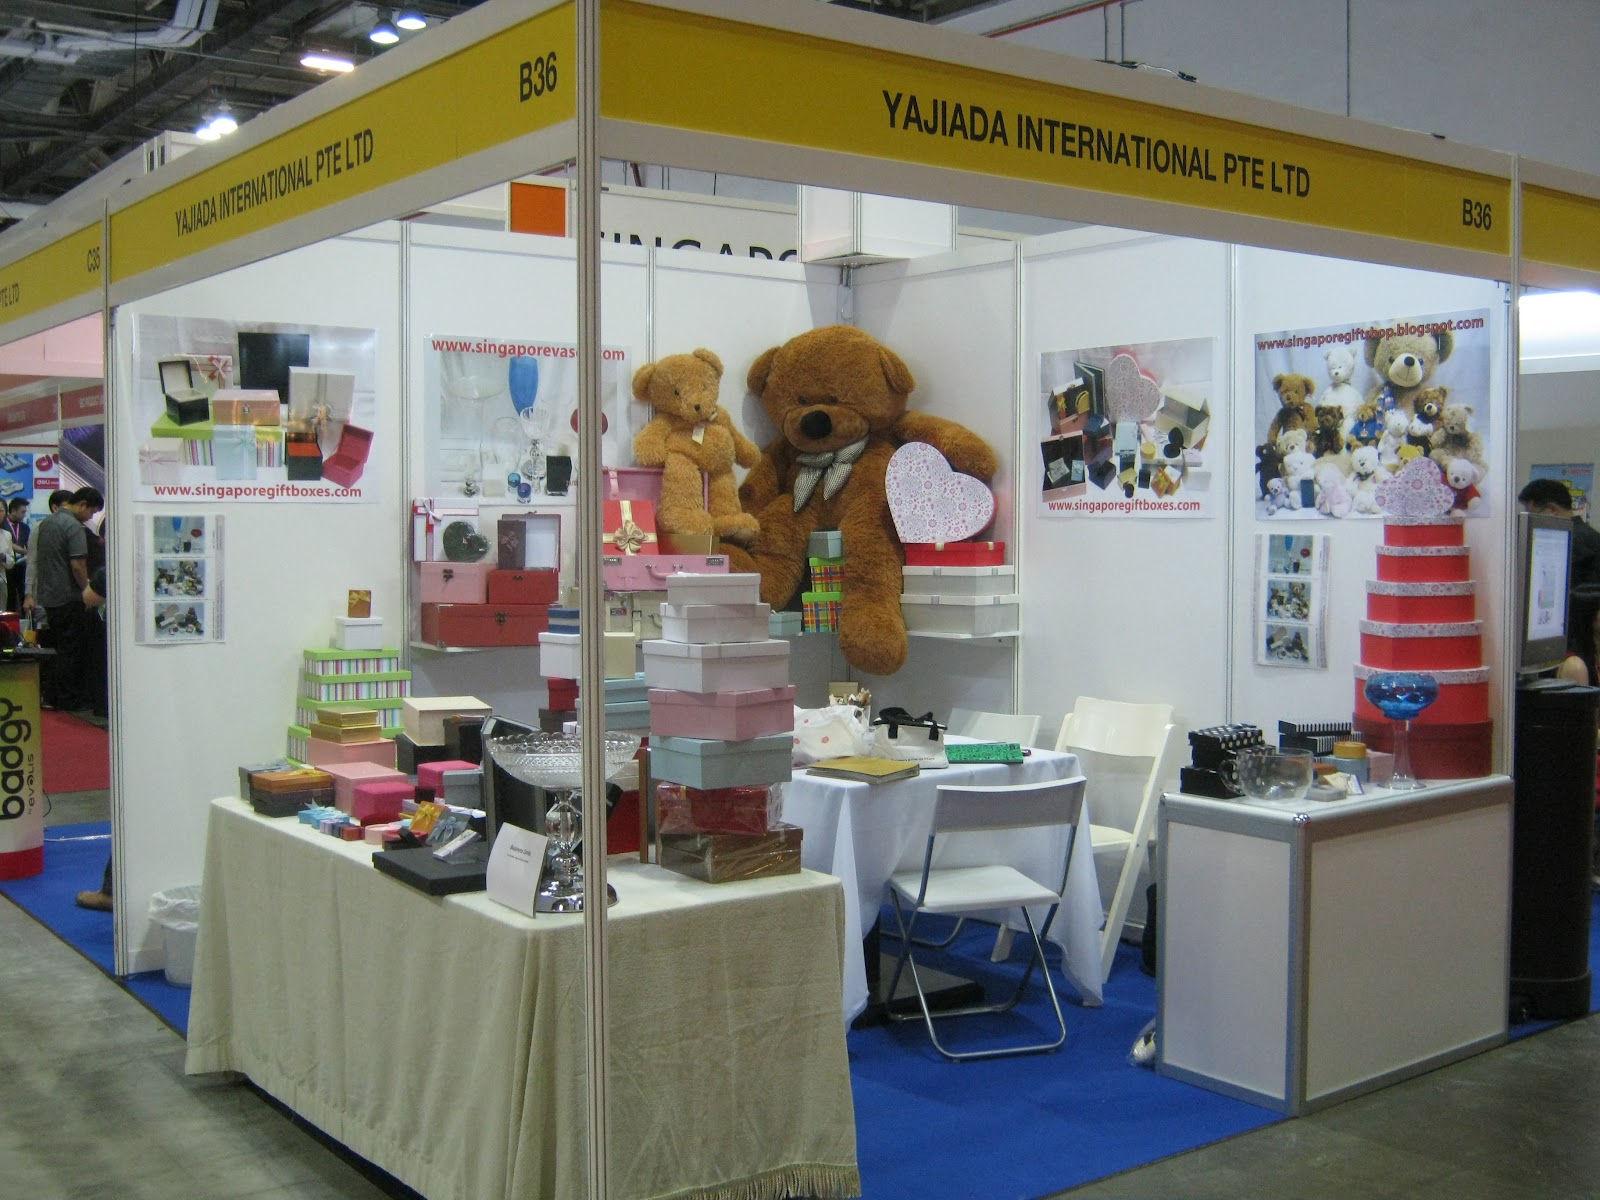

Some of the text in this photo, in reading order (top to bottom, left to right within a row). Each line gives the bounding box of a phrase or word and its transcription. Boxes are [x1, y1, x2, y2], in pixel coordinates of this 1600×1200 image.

[519, 51, 558, 102] B36
[882, 90, 1311, 198] YAJIADA INTERNATIONAL PTE LTD
[175, 128, 374, 237] YAJIADA INTERNATIONAL PTE LTD
[1462, 198, 1492, 231] B36
[1256, 316, 1484, 350] www.singaporegiftshop.blogspot.com
[154, 483, 362, 499] www.singaporegiftboxes.com
[1048, 499, 1200, 513] www.singaporegiftboxes.com
